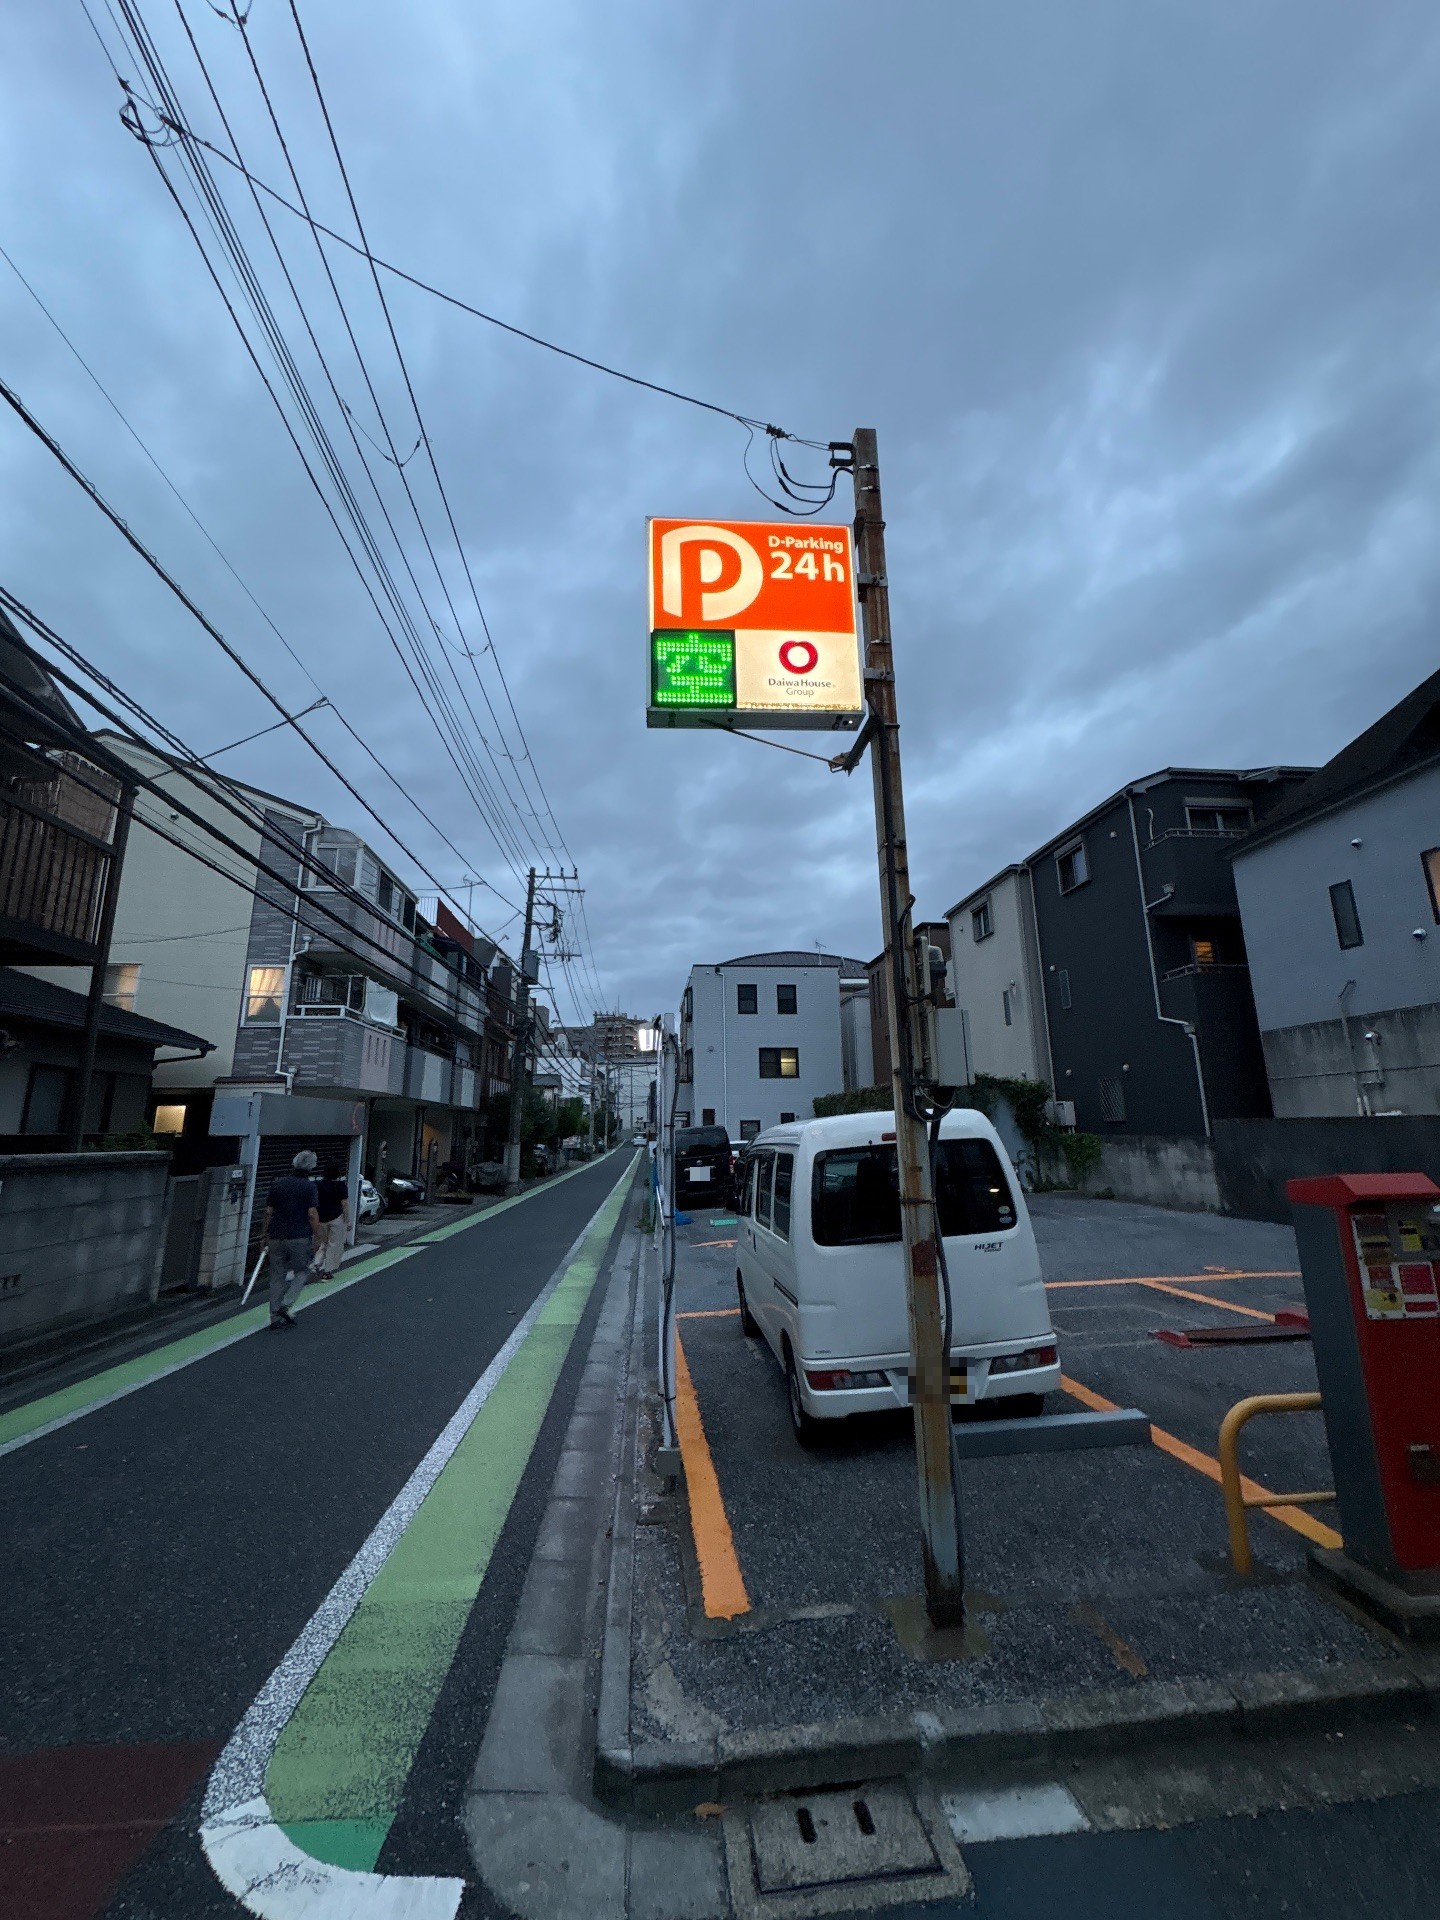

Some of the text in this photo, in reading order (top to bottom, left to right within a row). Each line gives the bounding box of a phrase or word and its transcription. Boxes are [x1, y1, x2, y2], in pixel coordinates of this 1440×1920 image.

[768, 535, 844, 554] D-Parking
[661, 525, 764, 621] P
[770, 550, 845, 583] 24h
[656, 633, 734, 704] 空
[768, 677, 832, 688] Daiwa House
[785, 687, 815, 698] Group
[974, 1241, 1004, 1250] HIJET
